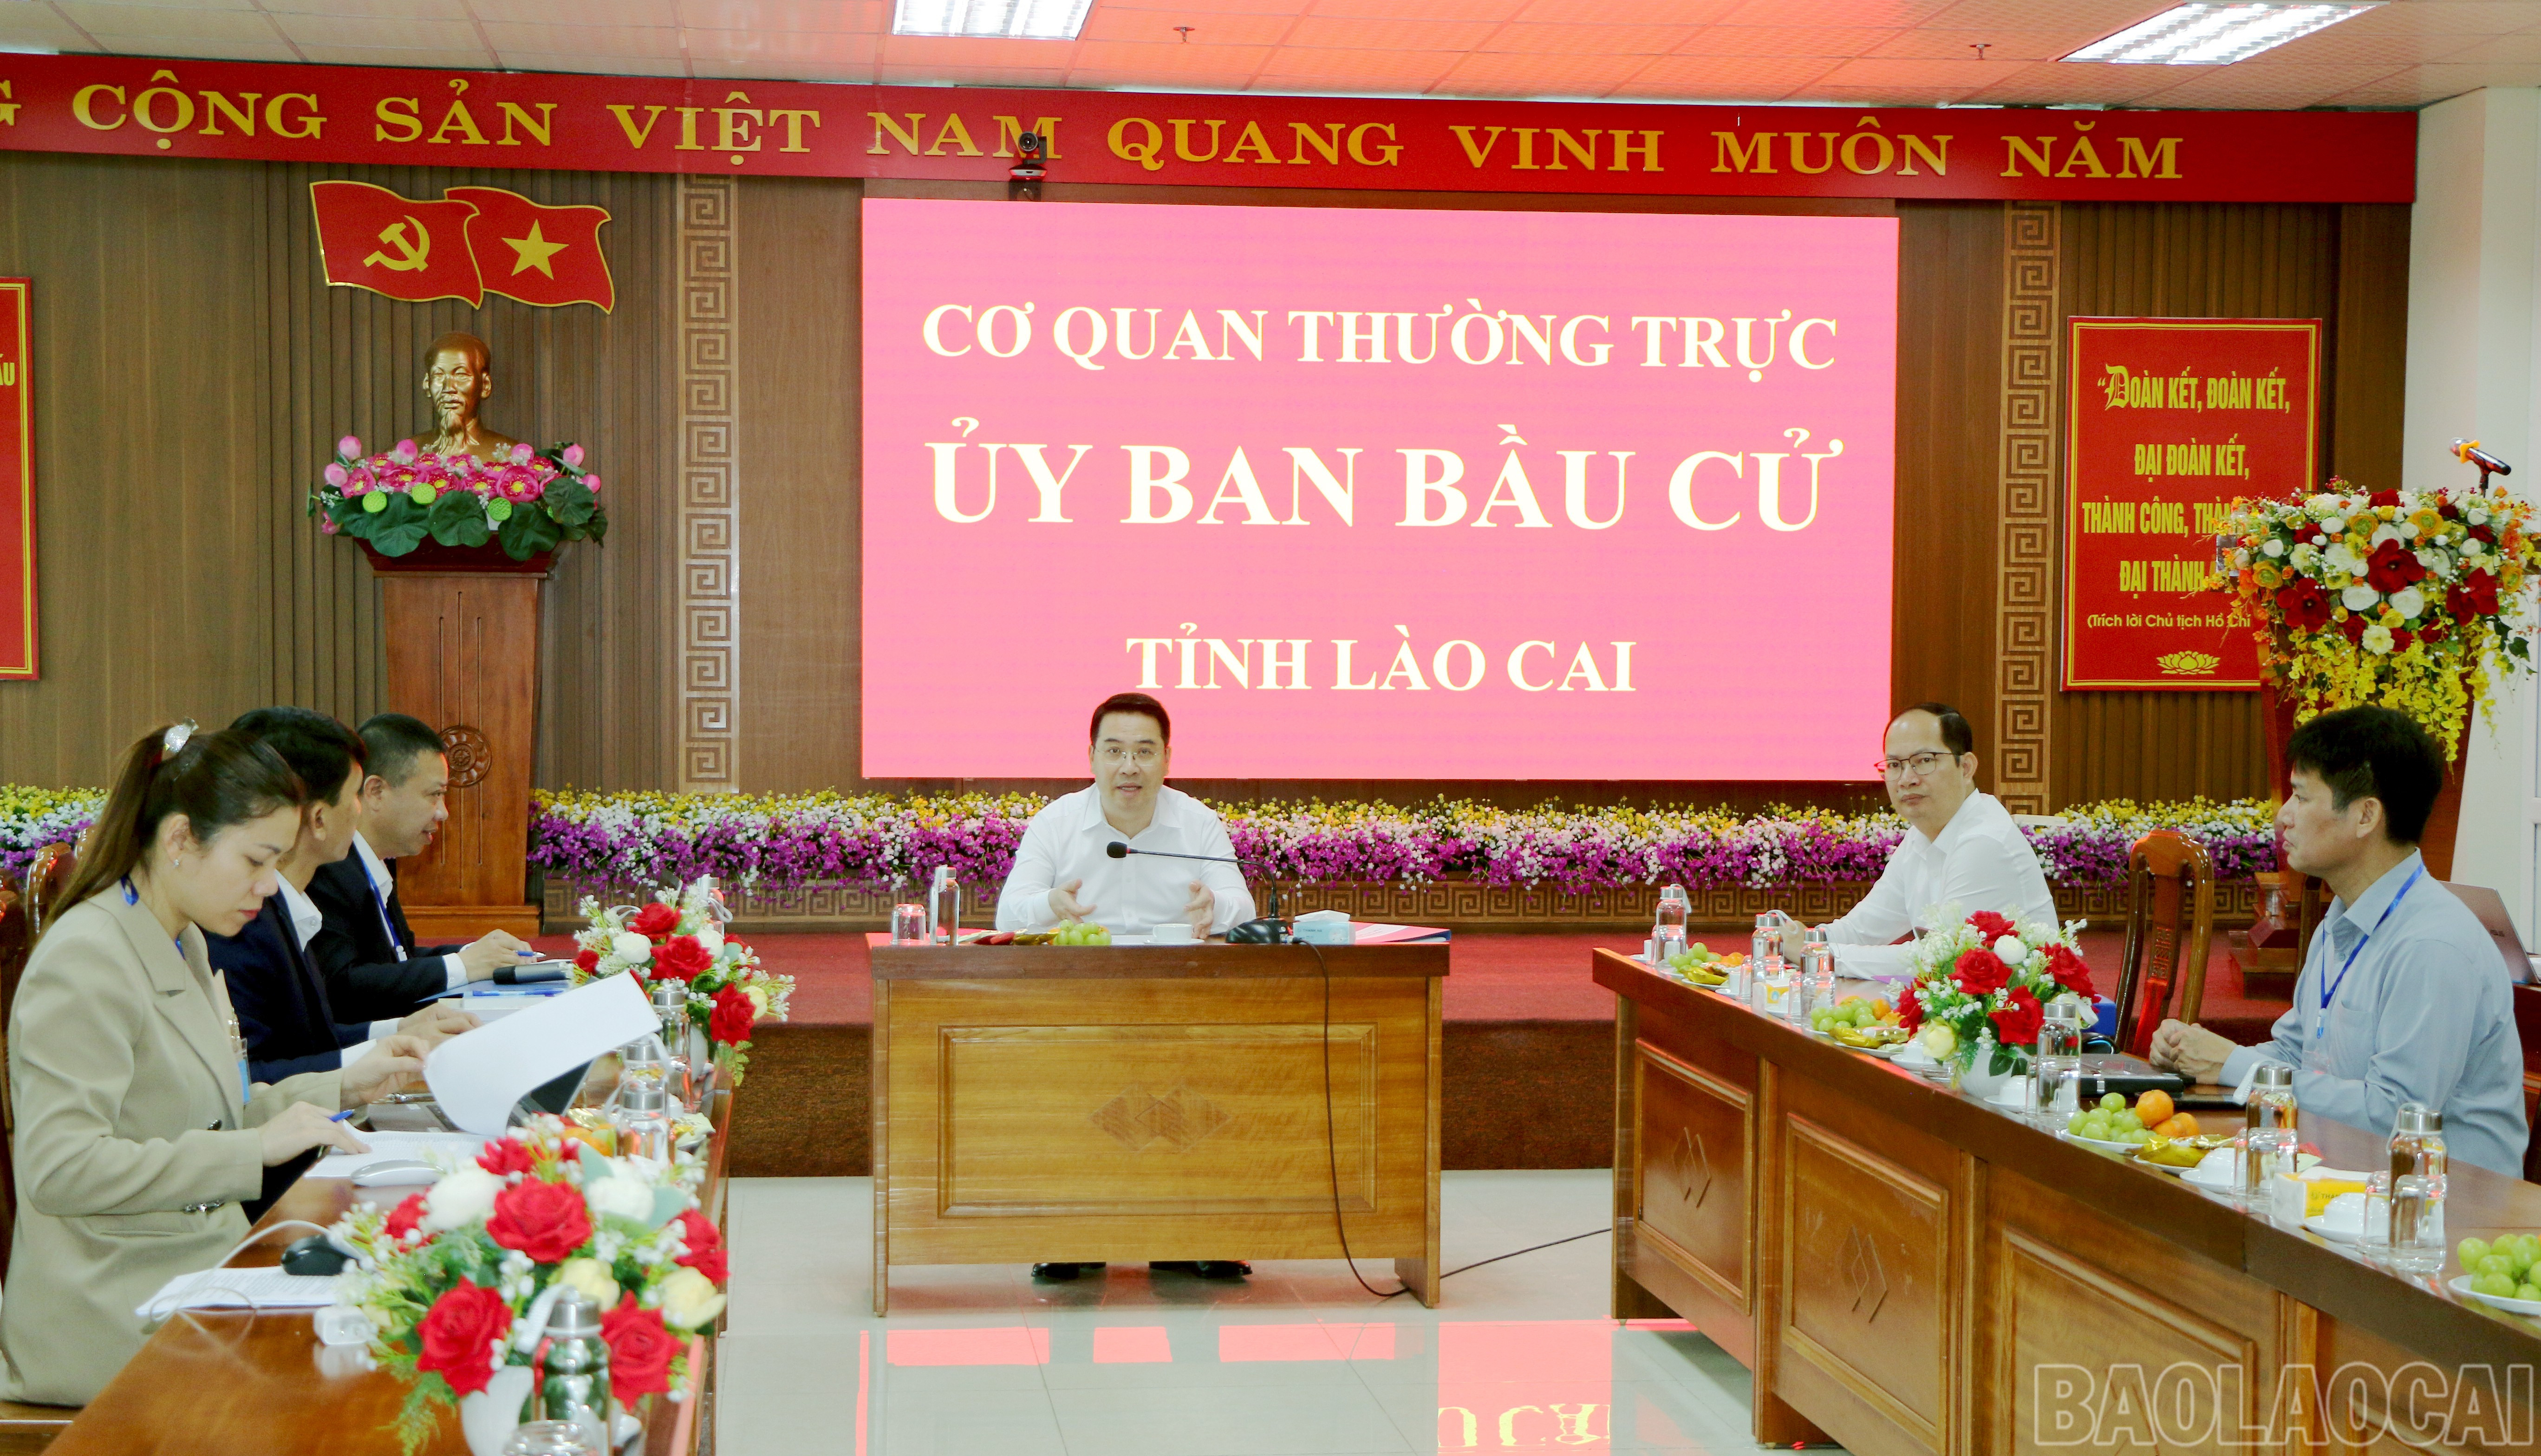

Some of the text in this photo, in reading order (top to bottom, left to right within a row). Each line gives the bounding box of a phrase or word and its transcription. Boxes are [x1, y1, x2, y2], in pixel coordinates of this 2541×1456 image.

[73, 70, 327, 149] CỘNG
[376, 79, 557, 145] SẢN
[606, 91, 820, 164] VIỆT
[868, 112, 1062, 158] NAM
[1108, 118, 1403, 170] QUANG
[1449, 126, 1663, 171] VINH
[1712, 117, 1952, 175] MUÔN
[2000, 121, 2183, 178] NĂM
[923, 299, 1836, 382] CƠ QUAN THƯỜNG TRỰC
[2168, 366, 2202, 412] KẾT,
[2207, 371, 2251, 409] ĐOÀN
[2256, 367, 2290, 413] KẾT,
[925, 417, 1843, 531] ỦY BAN BẦU CỬ
[2134, 433, 2249, 482] ĐẠI ĐOÀN KẾT,
[2082, 495, 2135, 533] THÀNH
[2140, 496, 2189, 538] CÔNG,
[2120, 561, 2147, 598] ĐẠI
[2152, 554, 2205, 592] THÀNH
[2088, 614, 2122, 628] (Trích
[2127, 614, 2142, 626] lời
[2146, 613, 2173, 627] Chủ
[2177, 615, 2202, 630] tịch
[2206, 613, 2224, 627] Hồ
[1127, 623, 1636, 691] TỈNH LÀO CAI
